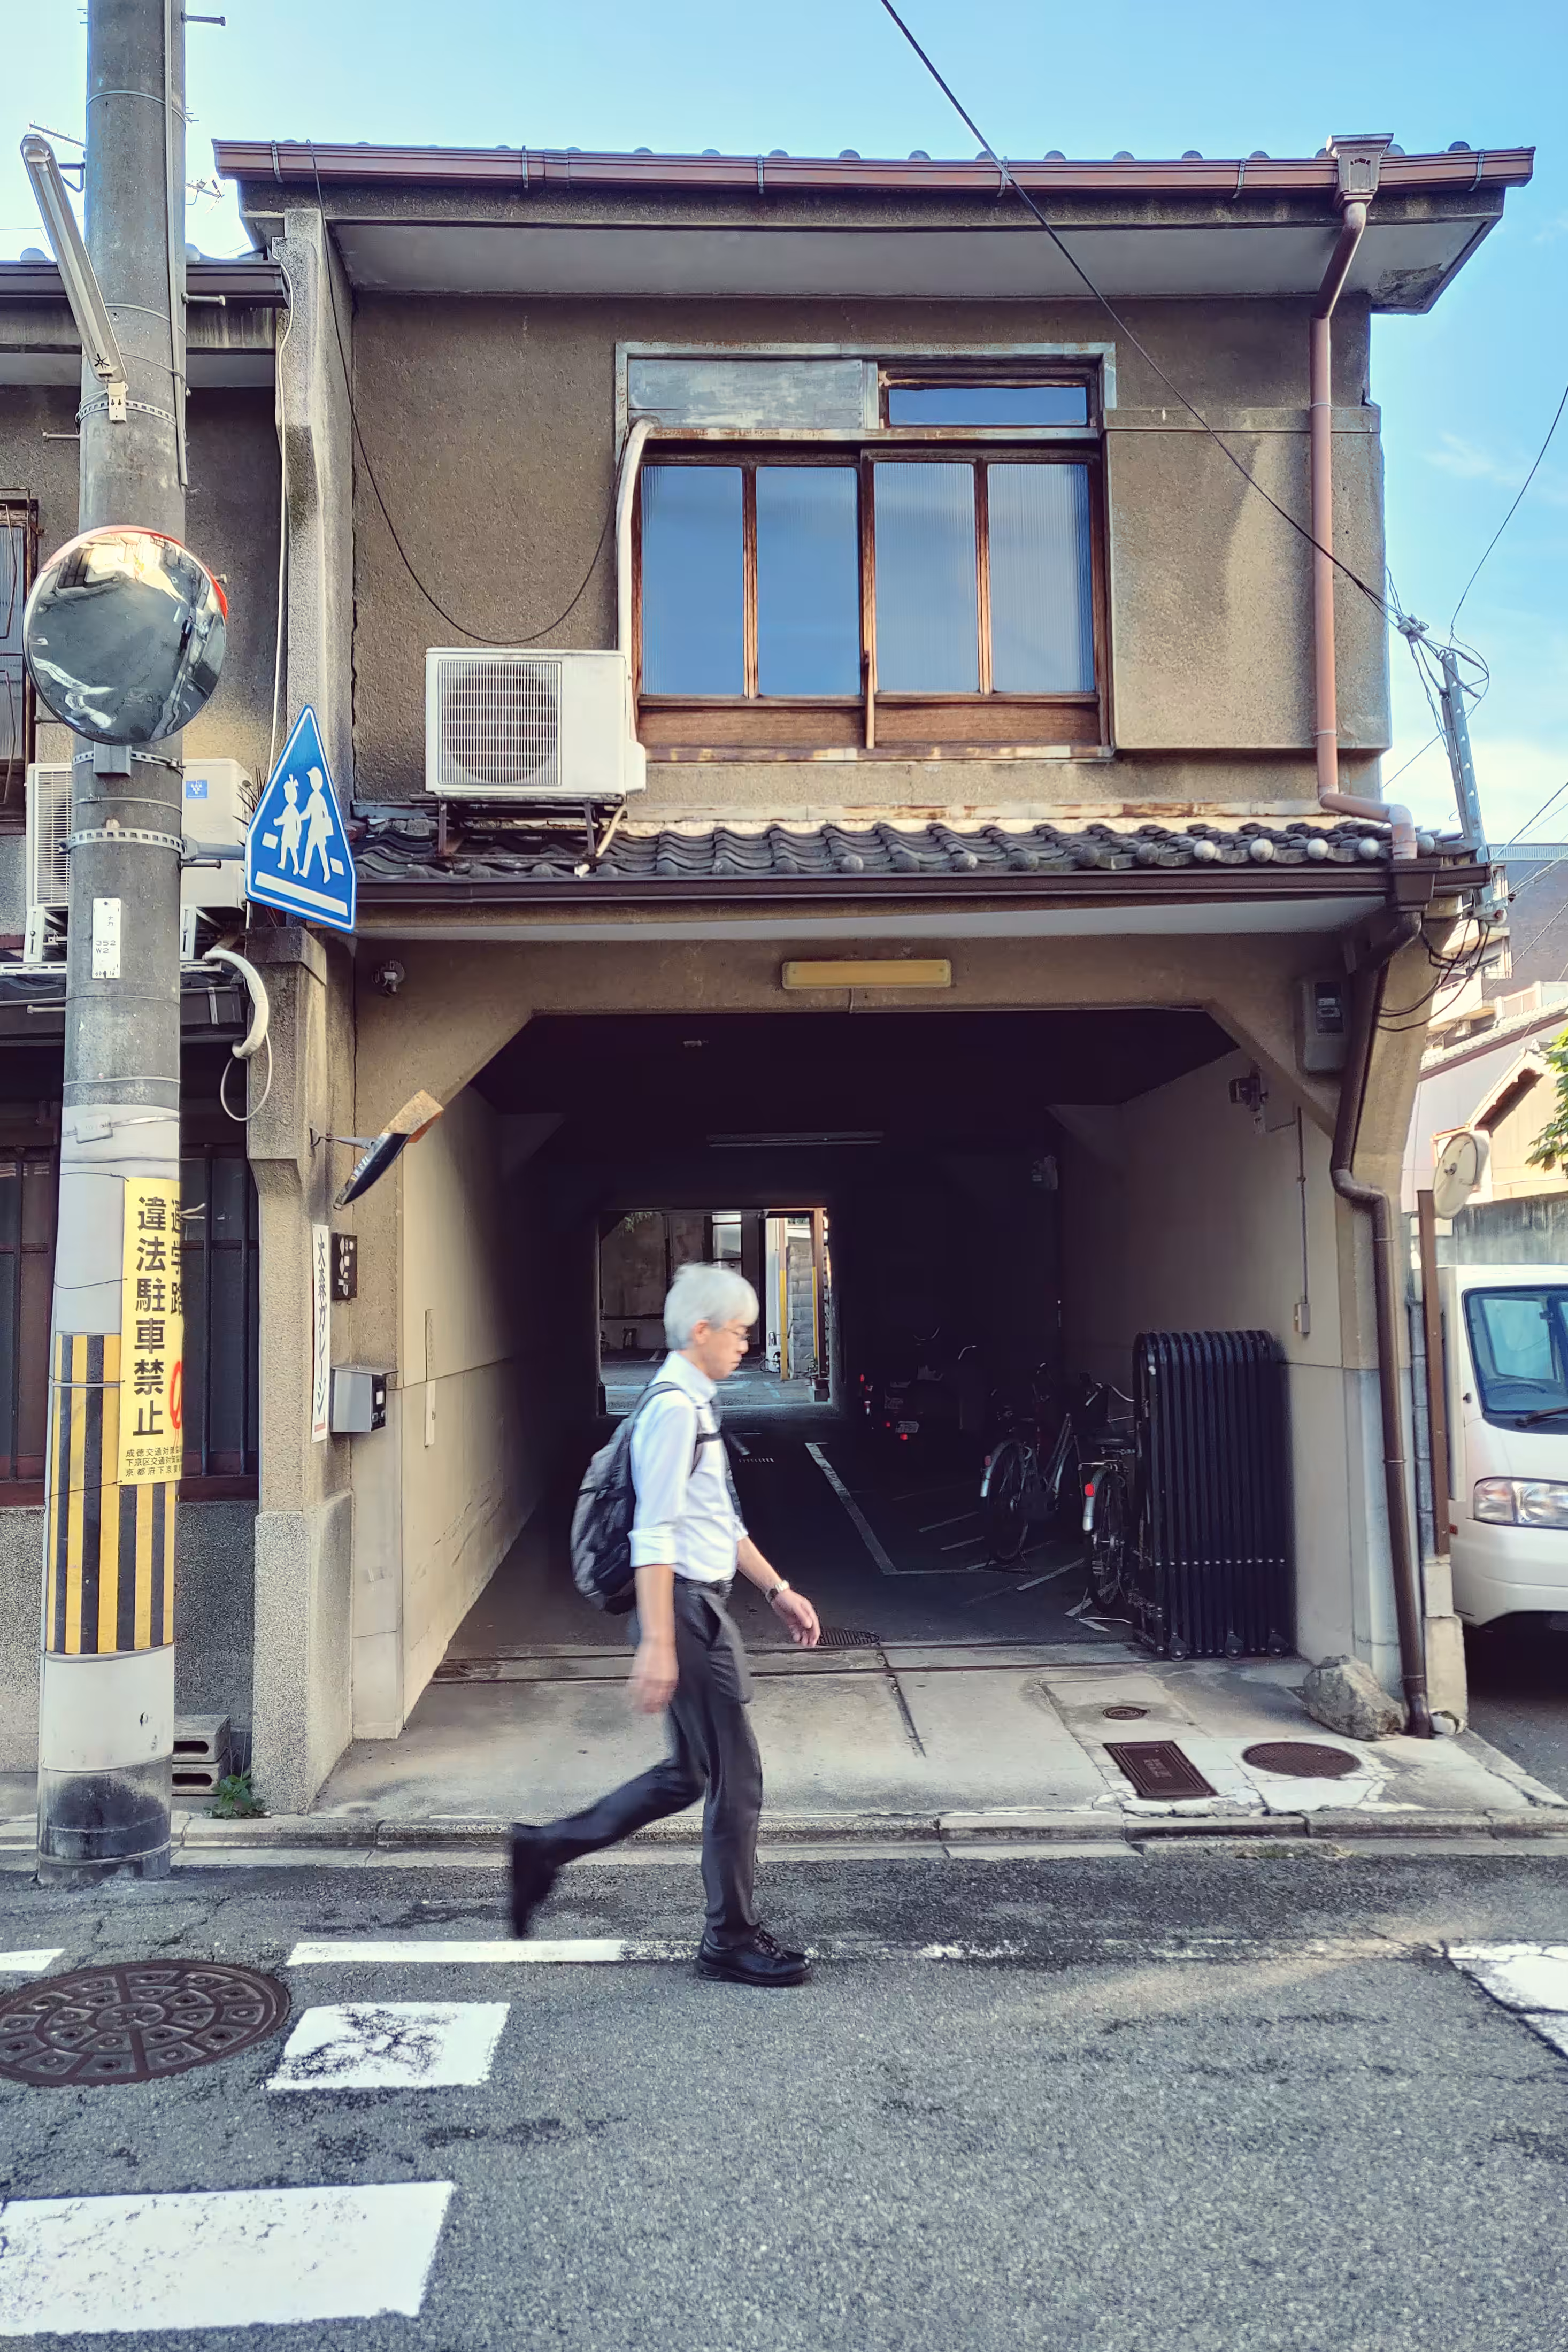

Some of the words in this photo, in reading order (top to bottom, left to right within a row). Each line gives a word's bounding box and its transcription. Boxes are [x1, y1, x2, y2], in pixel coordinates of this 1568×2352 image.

[133, 1196, 166, 1436] 違法駐車禁止
